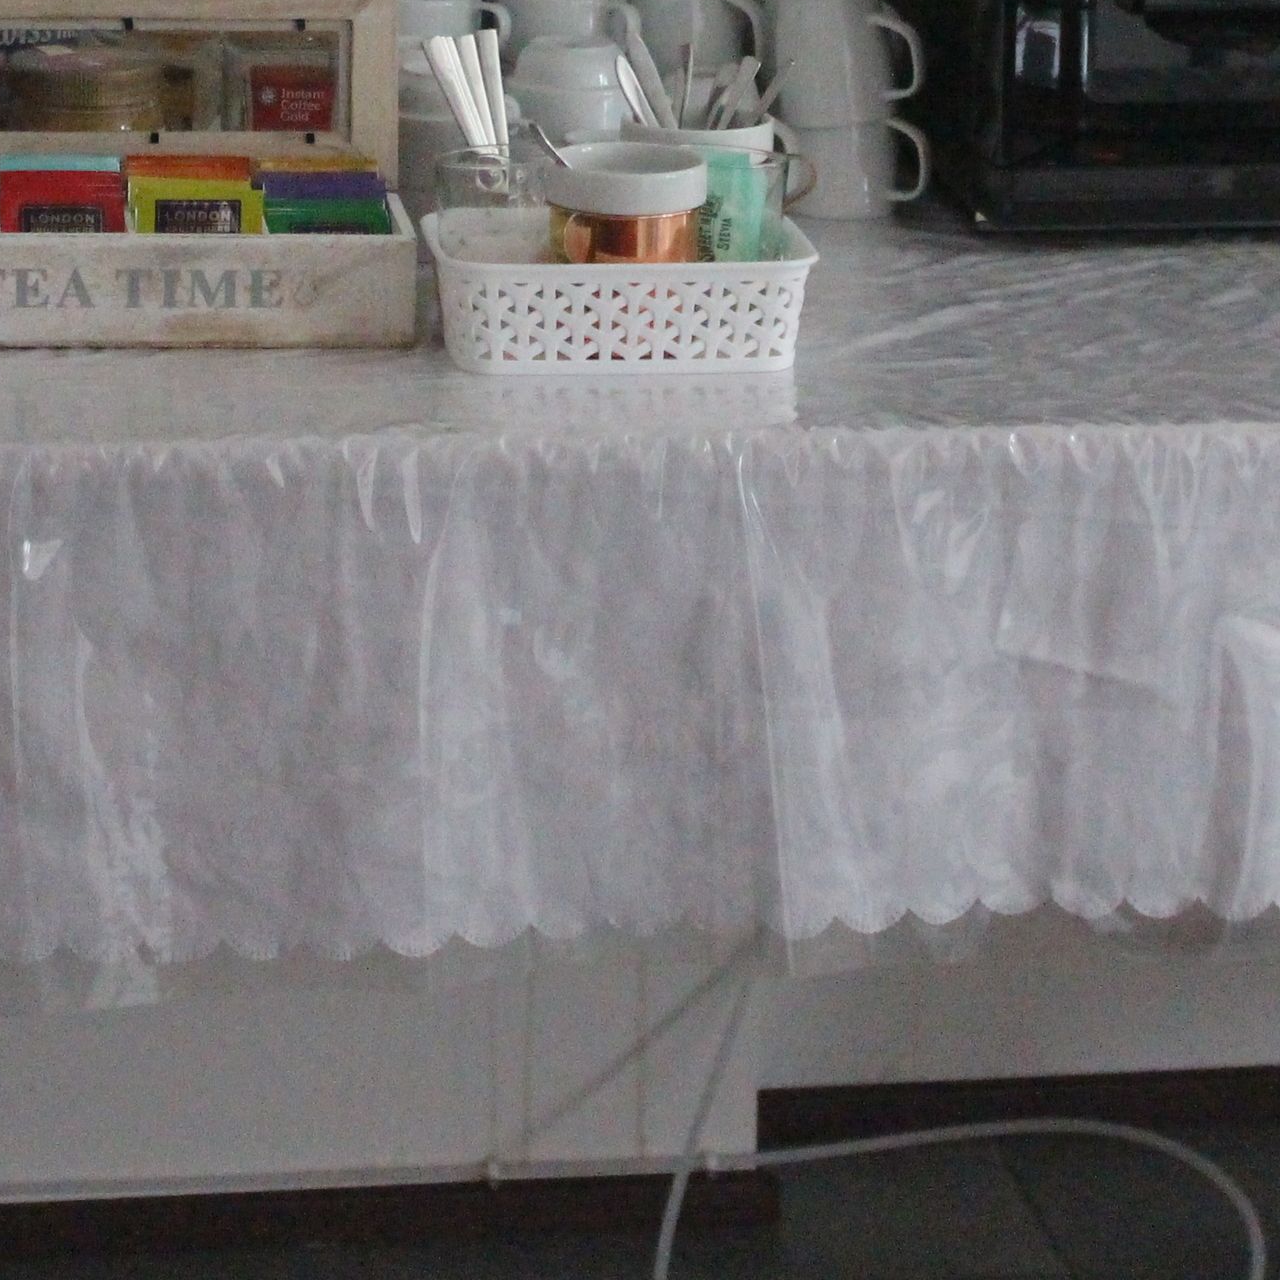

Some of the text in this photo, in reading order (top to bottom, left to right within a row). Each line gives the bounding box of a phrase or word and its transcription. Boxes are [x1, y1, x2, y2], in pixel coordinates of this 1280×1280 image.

[280, 88, 326, 99] Instant
[280, 100, 322, 111] Coffee
[280, 111, 310, 122] Gold
[29, 213, 96, 224] LONDON
[164, 210, 232, 222] LONDON
[717, 217, 732, 251] STEVIA
[114, 268, 286, 309] TIME
